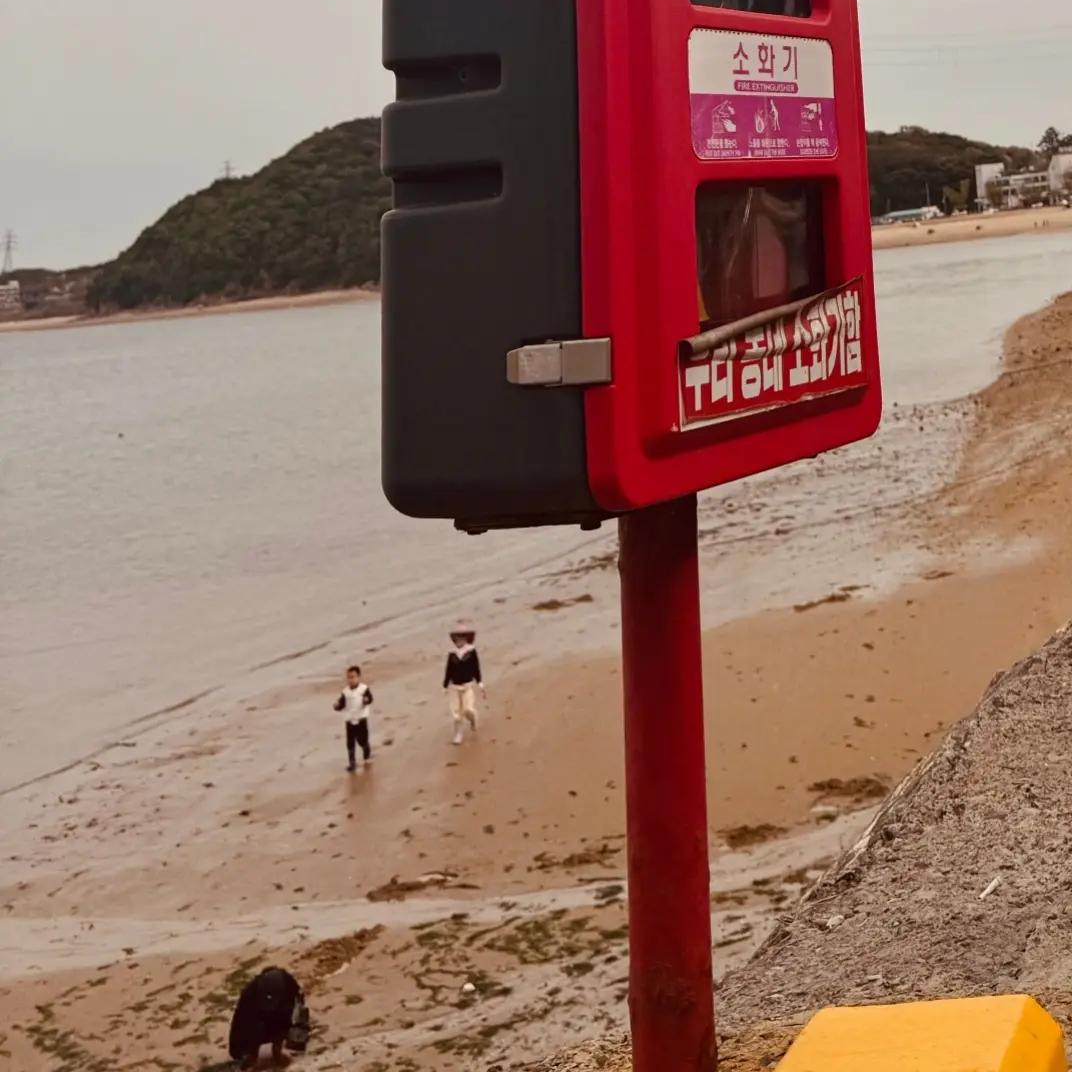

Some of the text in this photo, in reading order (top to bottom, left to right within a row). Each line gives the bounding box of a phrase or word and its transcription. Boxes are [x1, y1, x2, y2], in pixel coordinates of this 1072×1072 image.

[732, 41, 799, 80] 소화기
[737, 81, 796, 92] FIRE EXTINGUISHER
